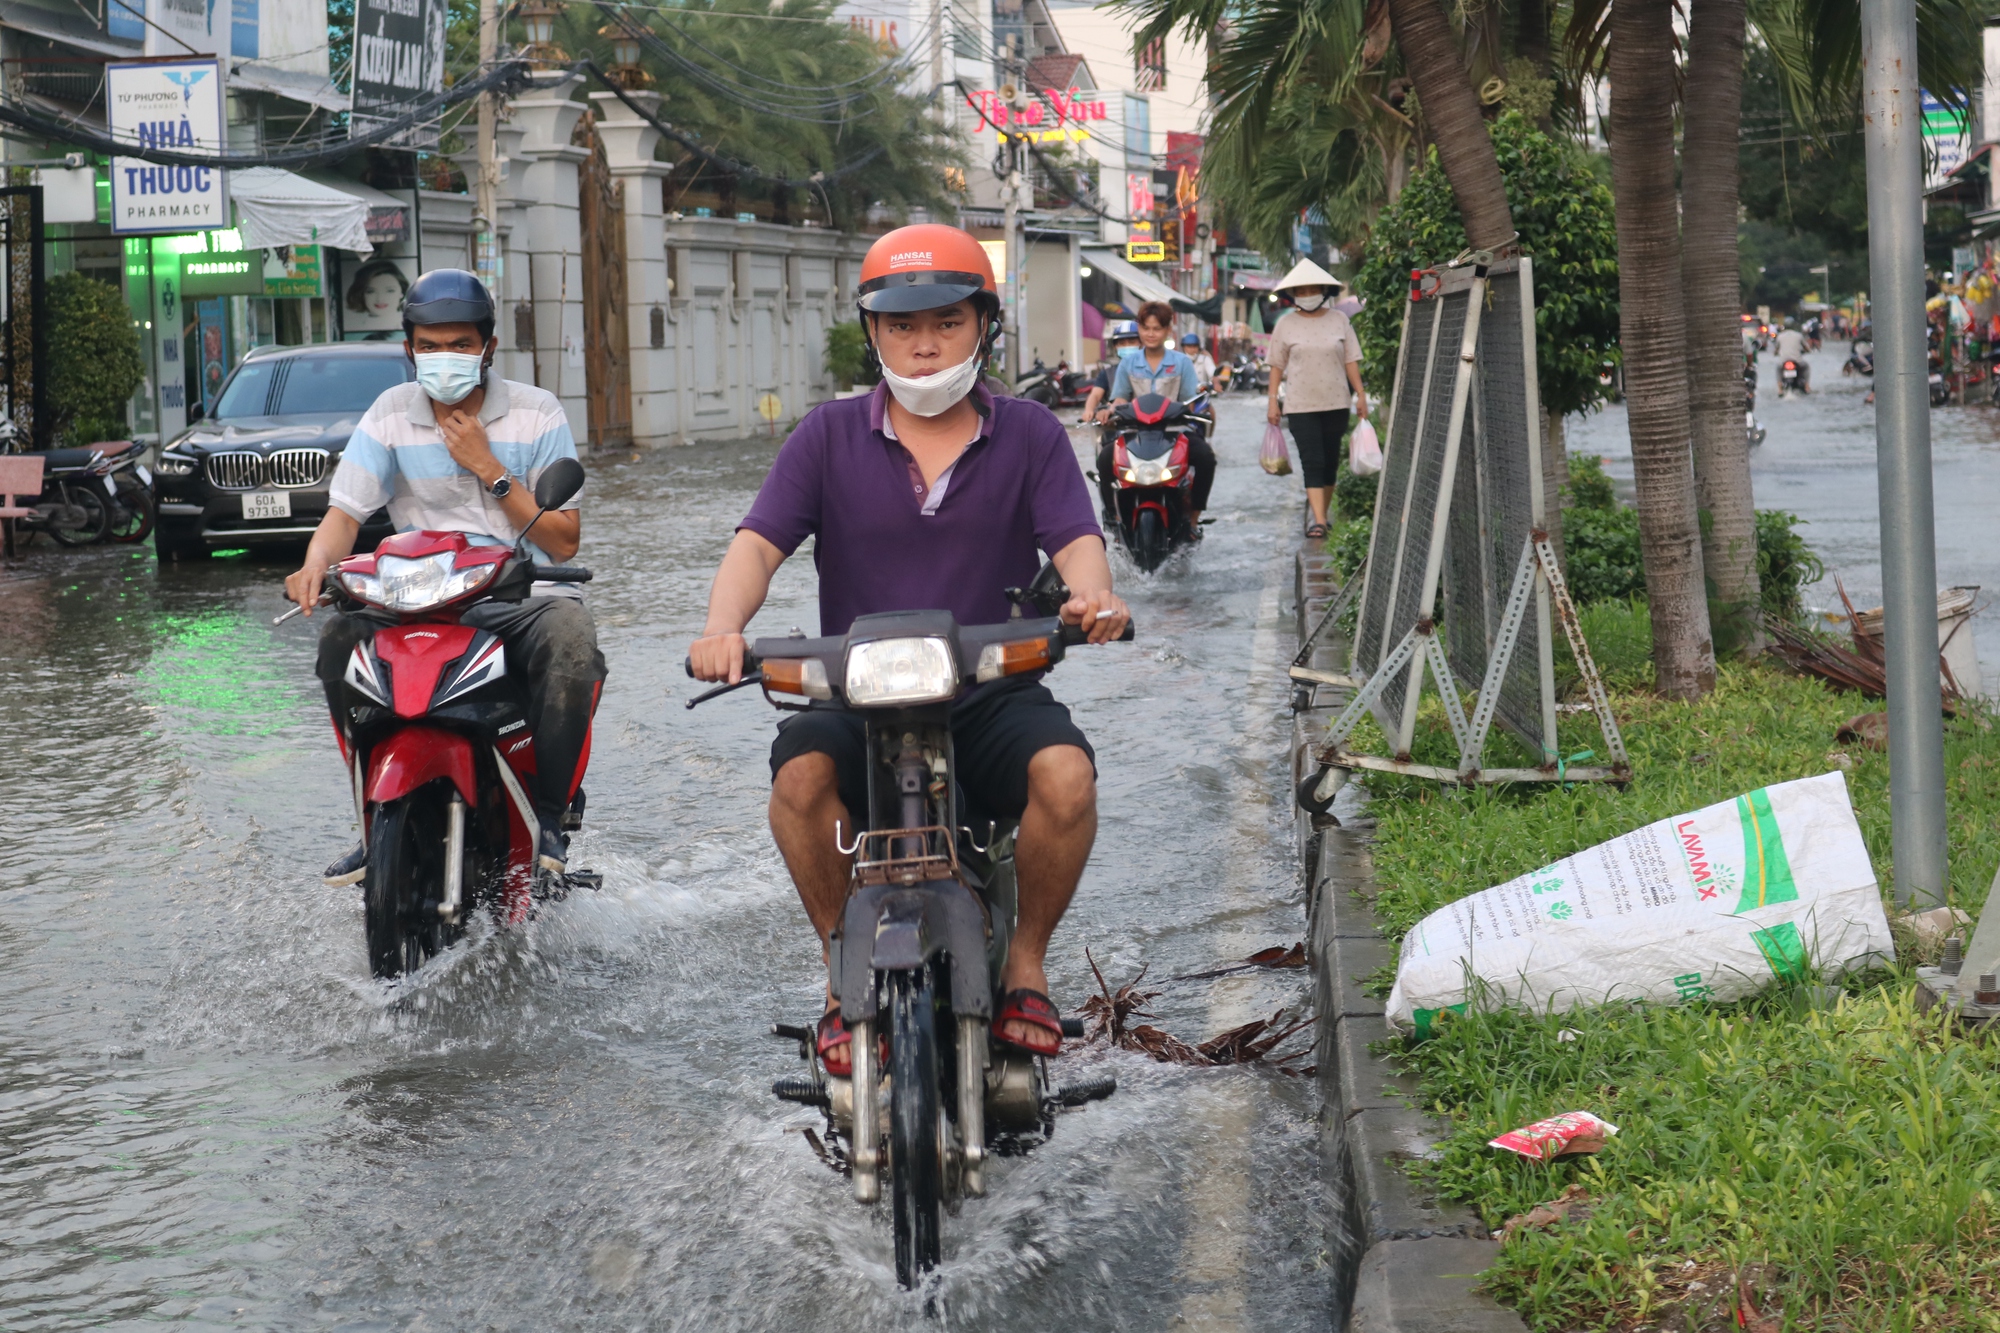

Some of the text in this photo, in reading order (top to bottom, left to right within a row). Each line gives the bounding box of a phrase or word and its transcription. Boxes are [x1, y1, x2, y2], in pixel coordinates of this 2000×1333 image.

[393, 40, 422, 90] LAM
[138, 113, 194, 150] NHÀ
[128, 204, 210, 218] PHARMACY
[890, 251, 933, 262] HANSAE
[187, 261, 249, 275] PHARMACY
[255, 495, 276, 506] 60A
[248, 506, 286, 518] 973.68
[404, 631, 440, 640] HONDA
[498, 719, 526, 736] HONDA
[1677, 819, 1718, 902] LAVAMIX
[1673, 972, 1716, 1003] ĐẤ
